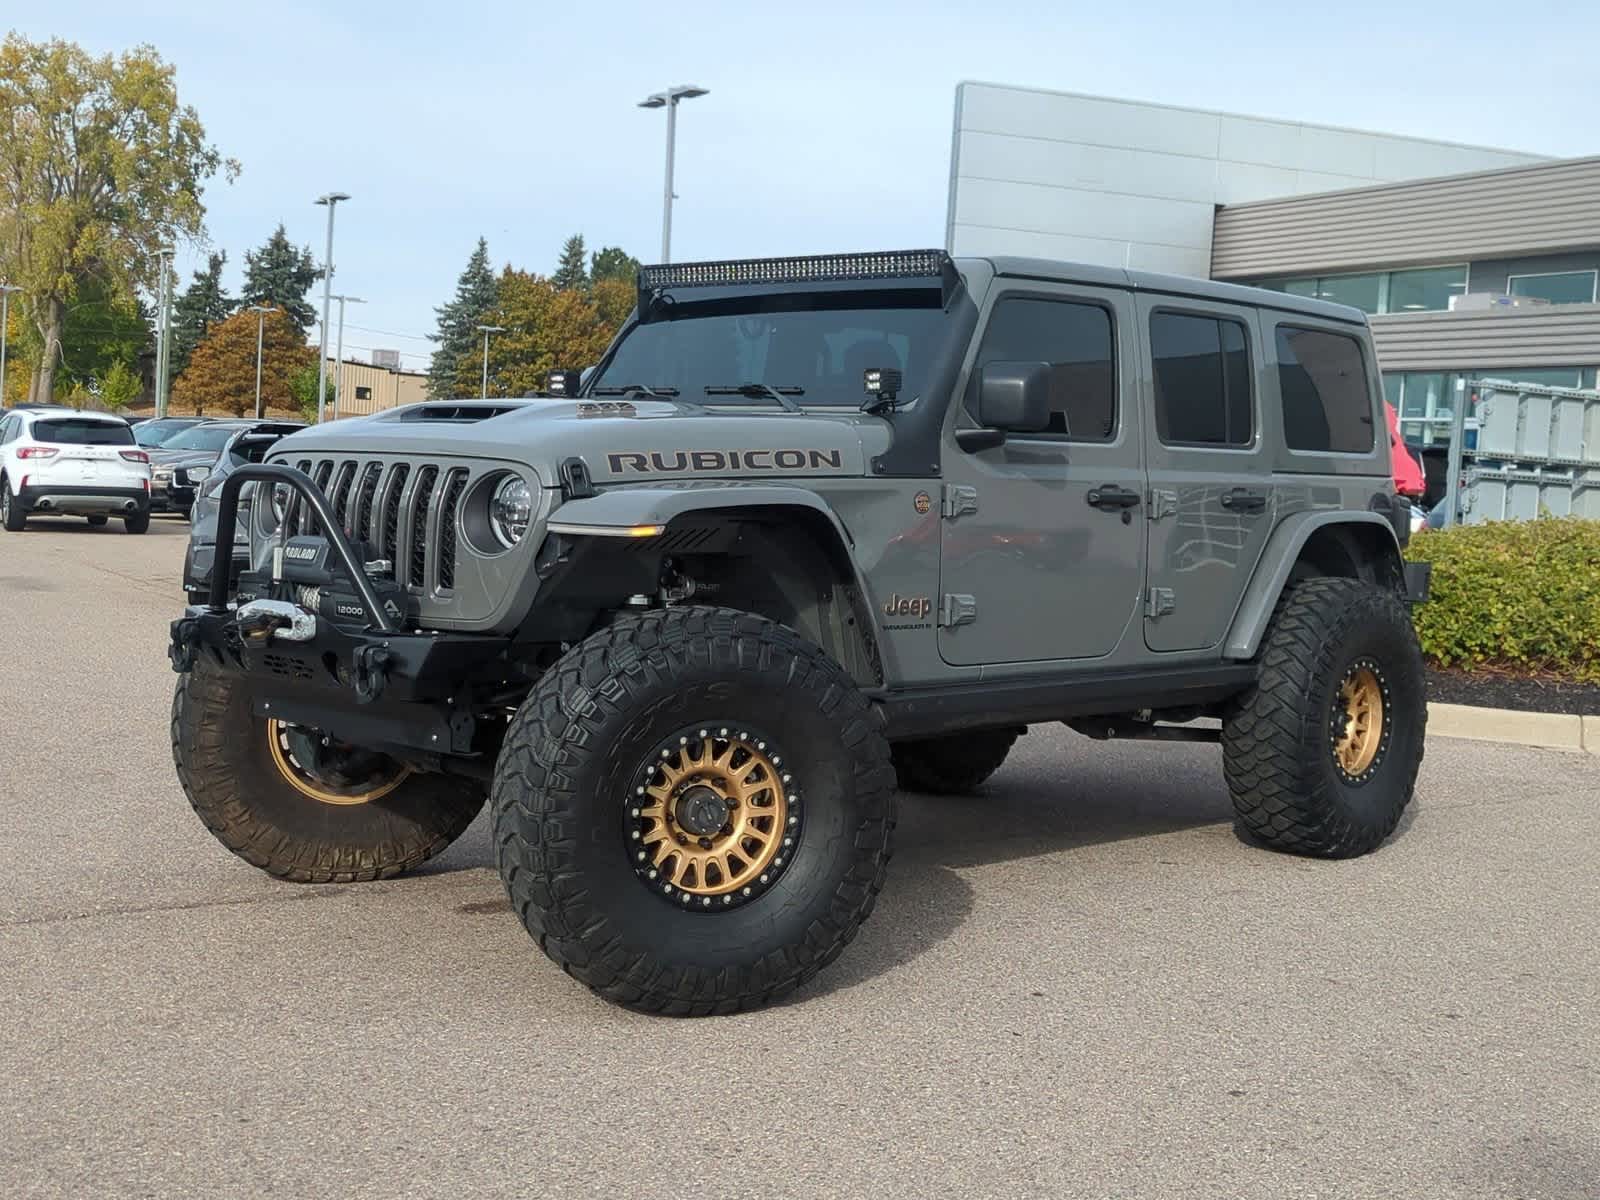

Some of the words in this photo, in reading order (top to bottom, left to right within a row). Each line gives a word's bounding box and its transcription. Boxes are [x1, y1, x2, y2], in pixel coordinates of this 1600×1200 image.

[608, 451, 841, 473] RUBICON
[338, 606, 363, 615] 12000
[884, 592, 930, 619] Jeep
